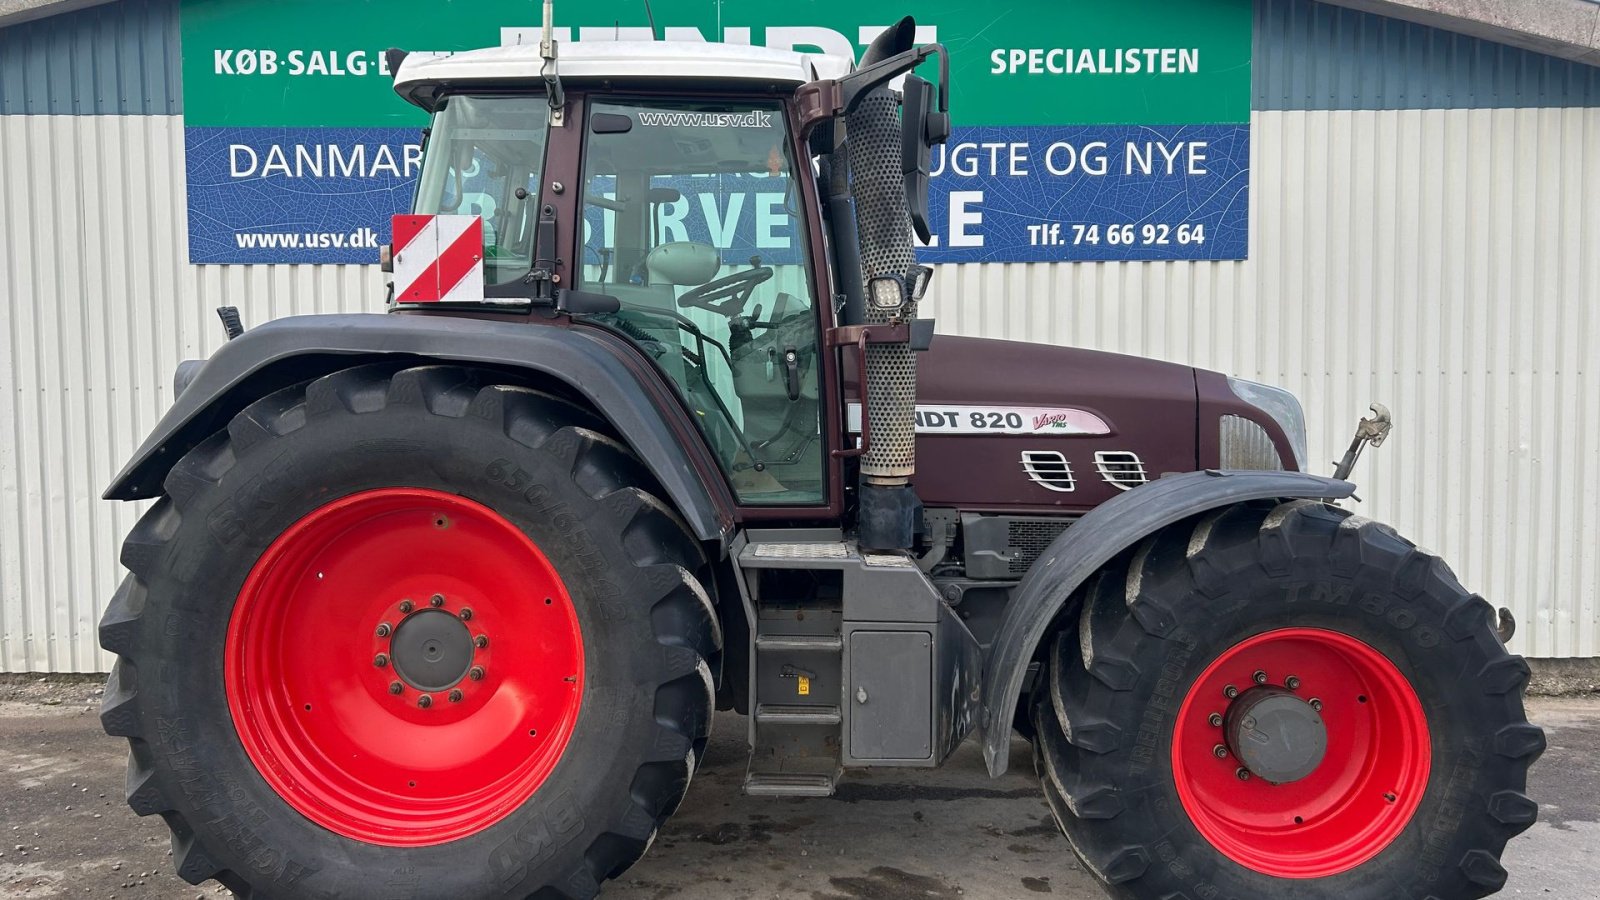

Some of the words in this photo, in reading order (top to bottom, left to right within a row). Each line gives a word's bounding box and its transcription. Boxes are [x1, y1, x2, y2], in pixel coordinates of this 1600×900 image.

[990, 48, 1199, 74] SPECIALISTEN
[639, 110, 772, 129] www.usv.dk
[1045, 141, 1108, 177] OG
[1126, 141, 1208, 176] NYE
[235, 228, 378, 249] www.usv.dk
[1027, 225, 1065, 246] Tlf.
[1072, 225, 1100, 245] 74
[1106, 225, 1136, 245] 66
[1142, 225, 1170, 245] 92
[1176, 224, 1206, 245] 64
[915, 411, 959, 428] NDT
[969, 412, 1023, 429] 820
